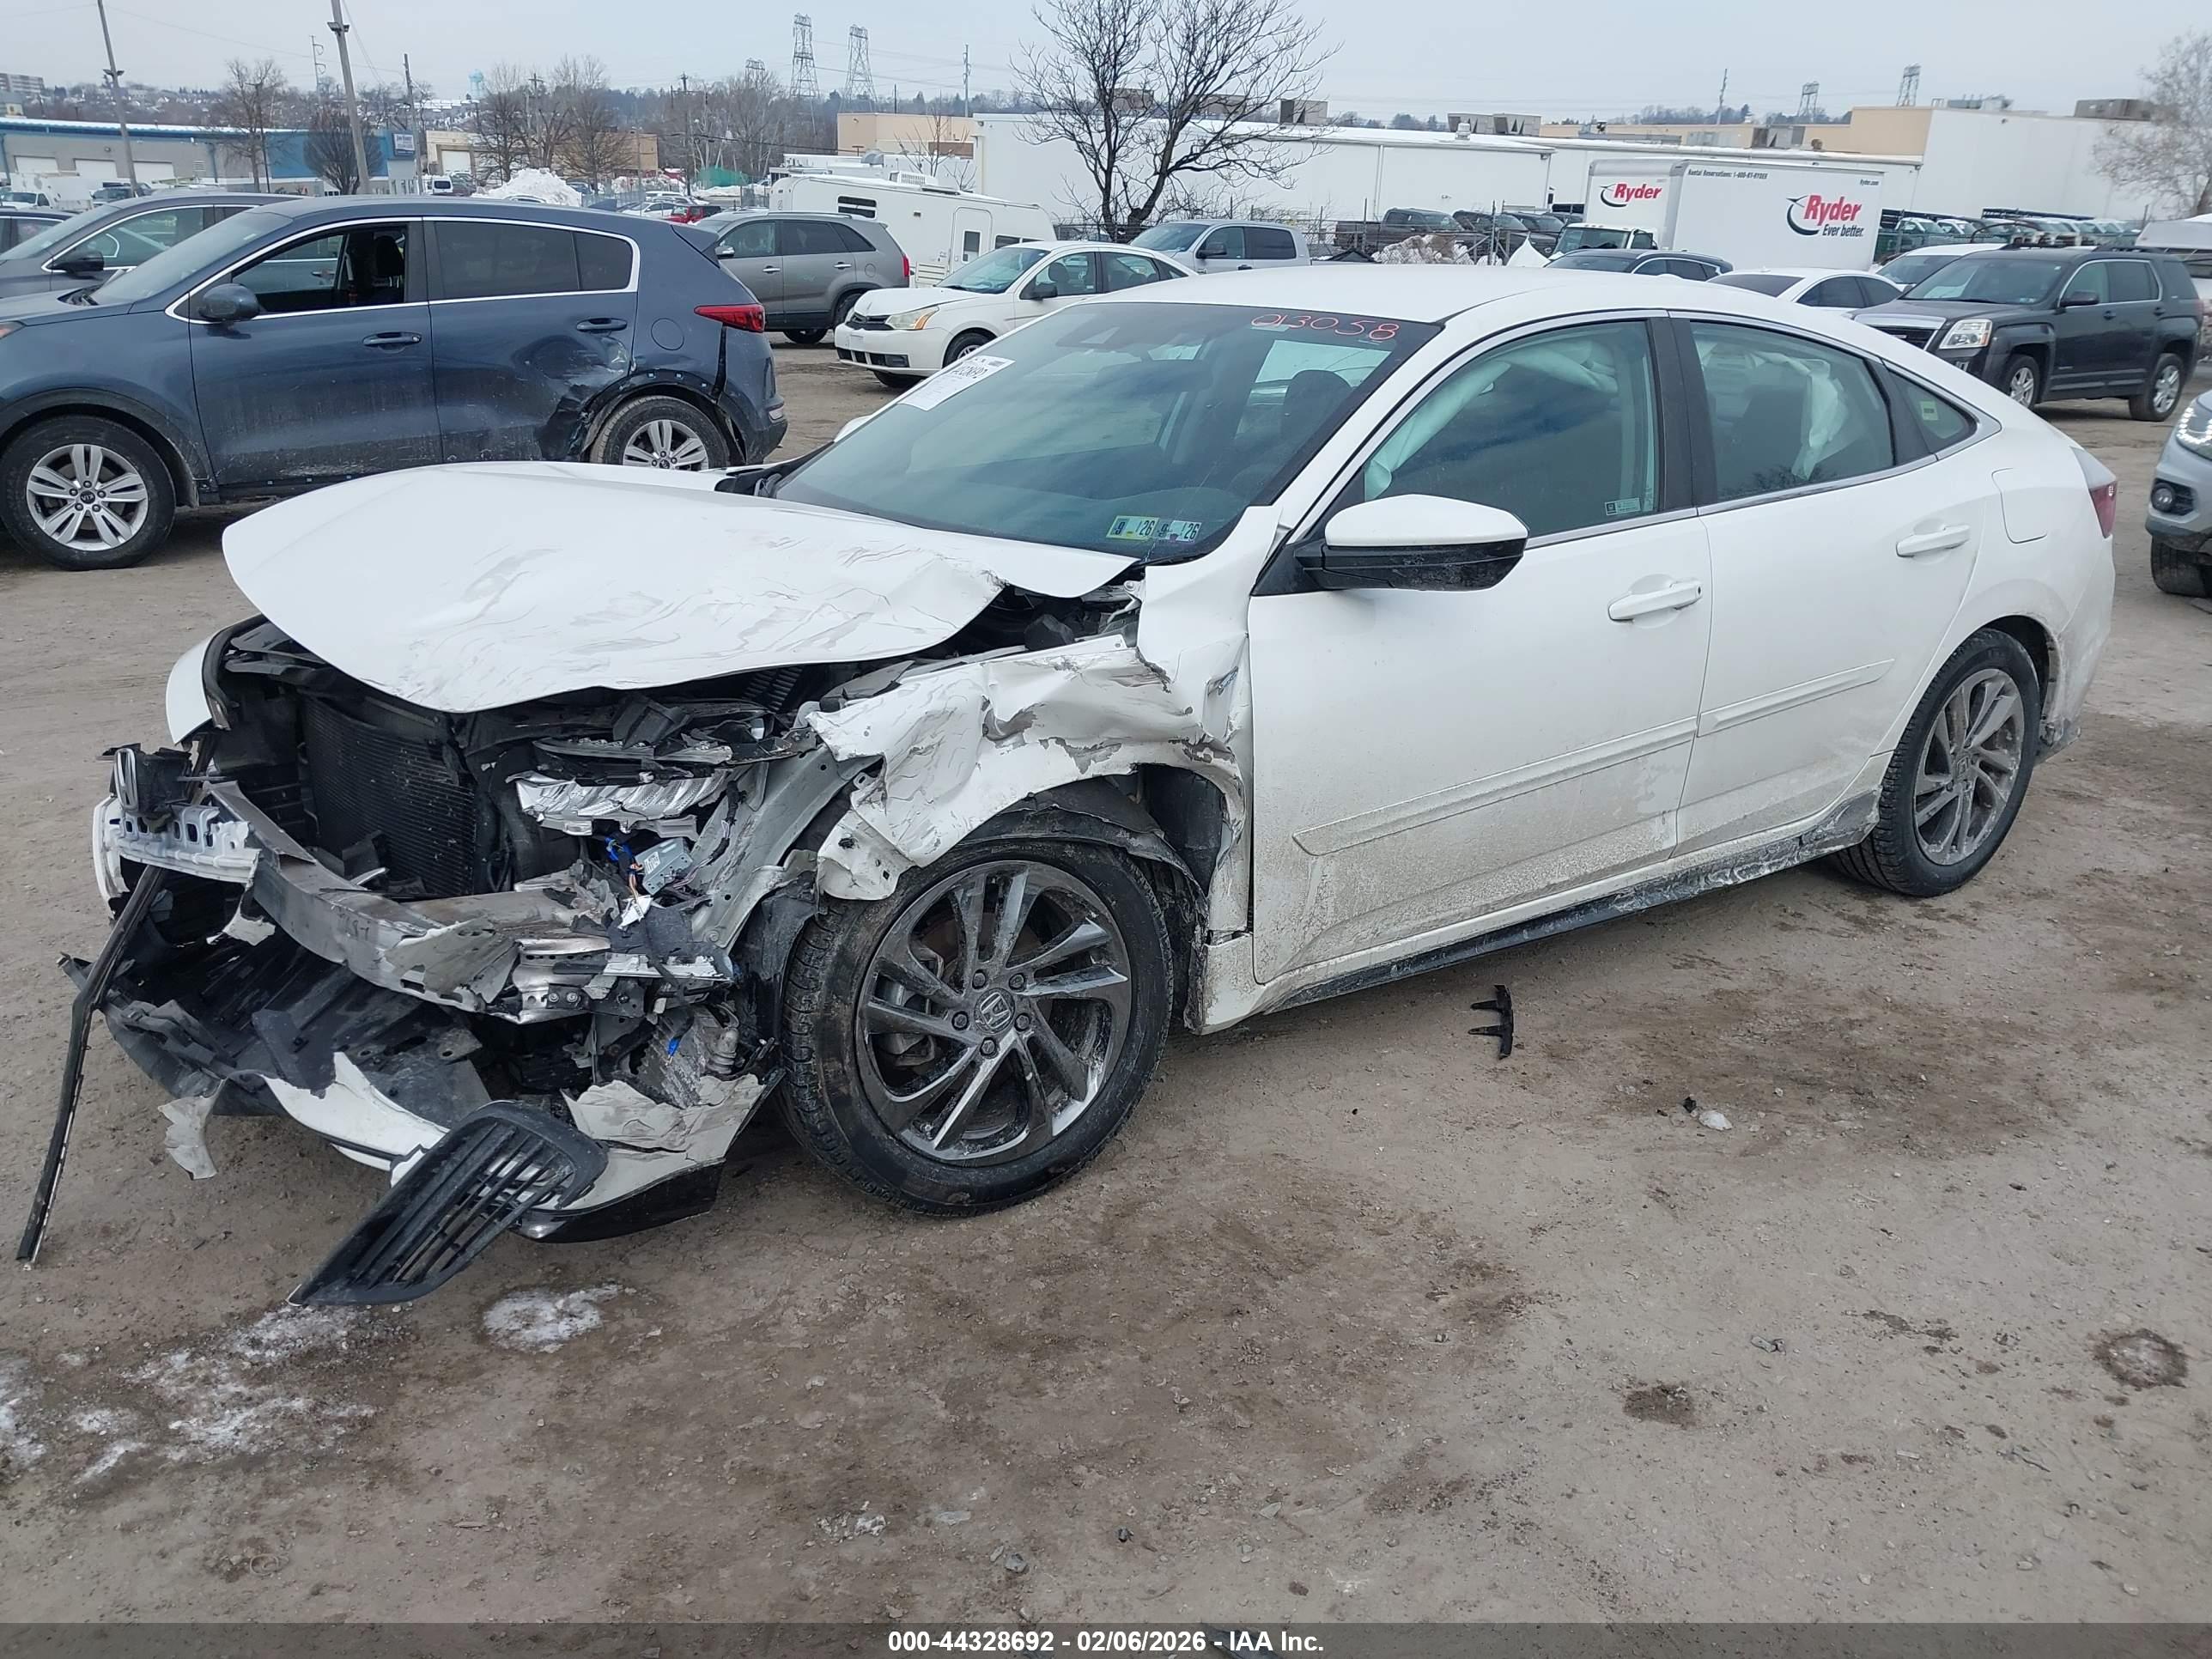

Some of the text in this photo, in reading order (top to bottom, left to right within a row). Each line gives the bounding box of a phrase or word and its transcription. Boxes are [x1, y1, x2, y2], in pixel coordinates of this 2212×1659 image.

[1613, 183, 1662, 203] Ryder
[1804, 194, 1862, 226] Ryder
[1822, 223, 1839, 236] Ever
[1184, 523, 1200, 539] 26
